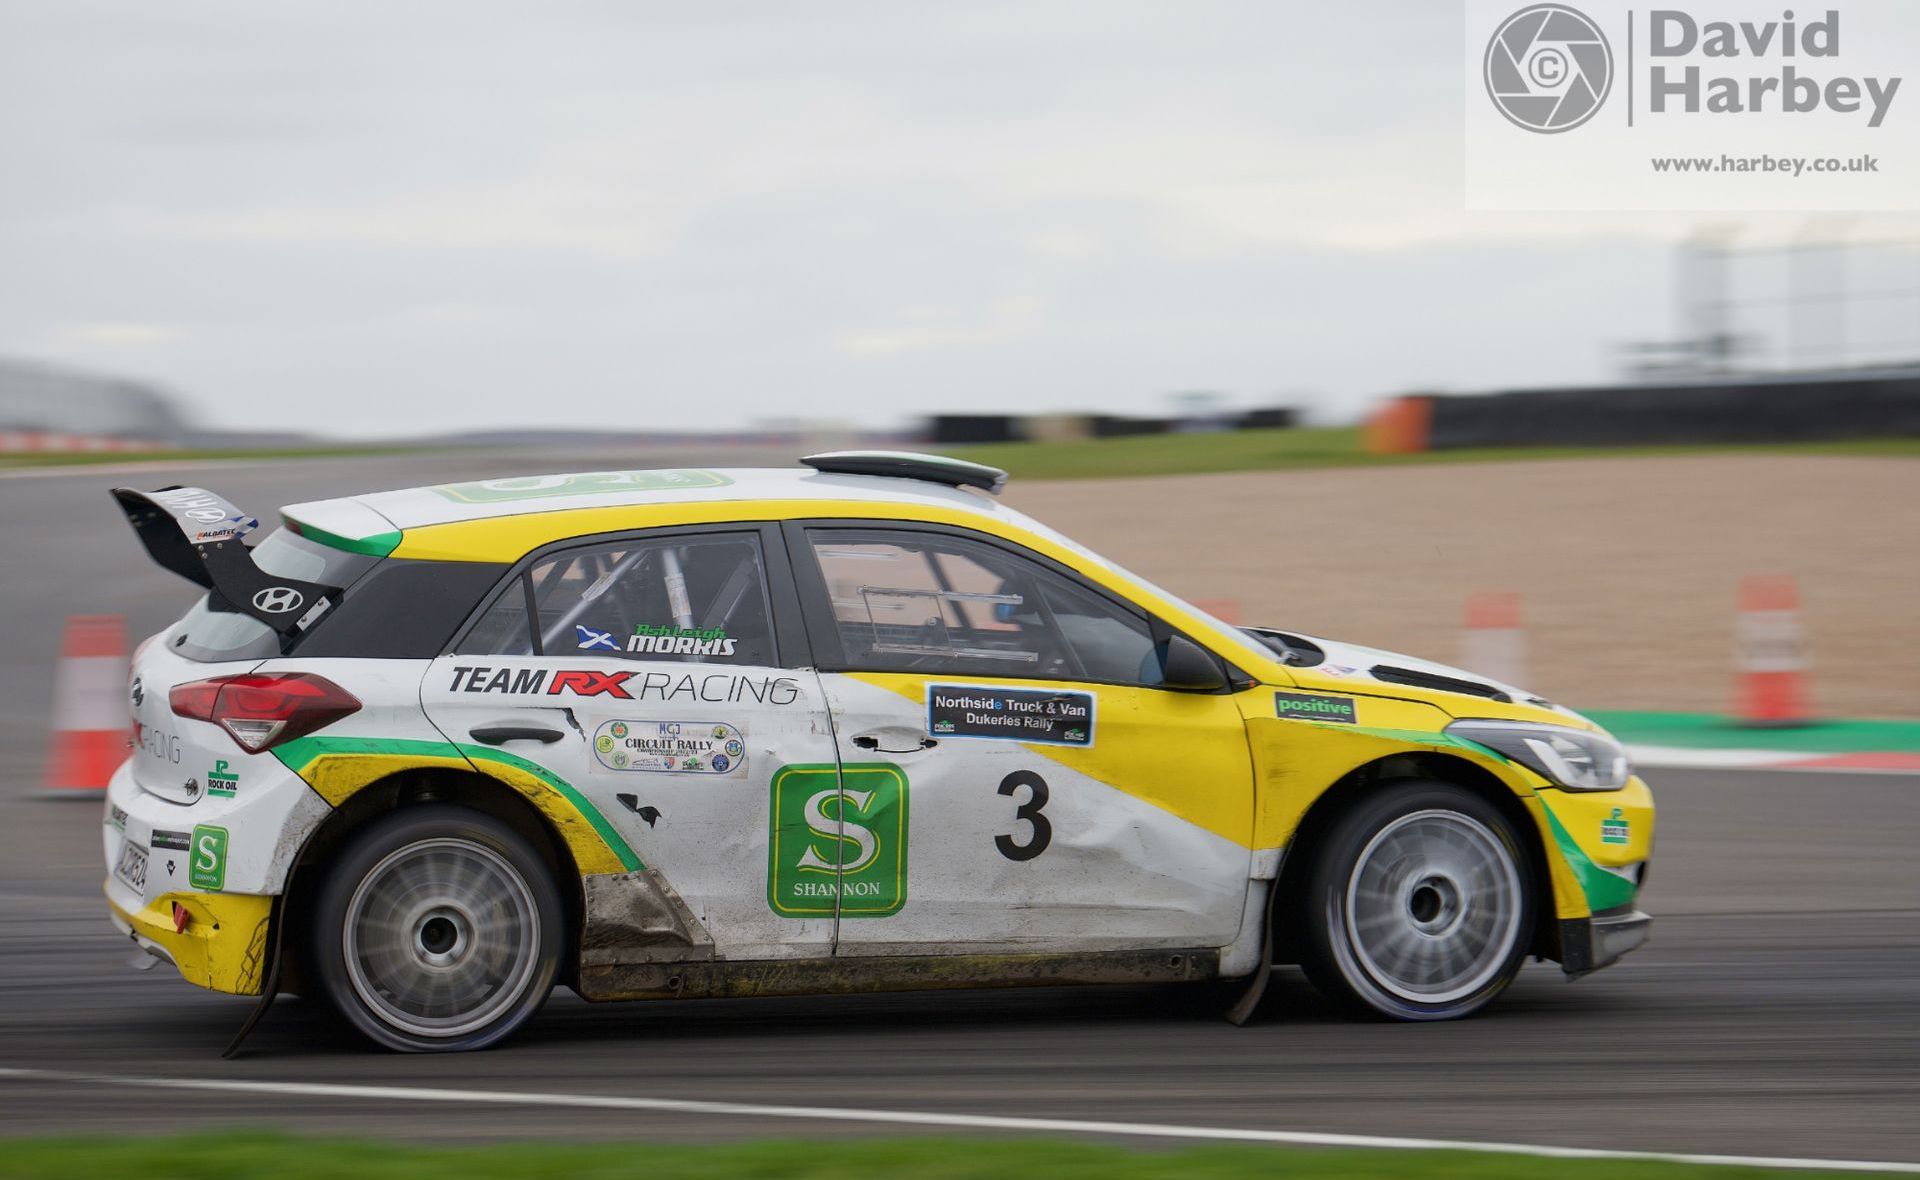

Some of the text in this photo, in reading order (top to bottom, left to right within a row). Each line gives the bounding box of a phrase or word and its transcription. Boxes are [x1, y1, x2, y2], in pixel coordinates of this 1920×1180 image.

[627, 635, 738, 656] MORRIS
[449, 666, 799, 705] TEAM RX RACING
[935, 696, 1086, 717] Northside Truck & Van
[1279, 698, 1352, 715] positive
[966, 713, 1021, 727] Dukeries
[1024, 717, 1054, 732] Rally
[625, 738, 673, 749] CIRCUIT
[677, 740, 713, 751] RALLY
[208, 779, 238, 791] ROCK OIL
[994, 769, 1052, 862] 3
[796, 788, 880, 874] S
[195, 835, 217, 871] S
[793, 881, 881, 897] SHANNON
